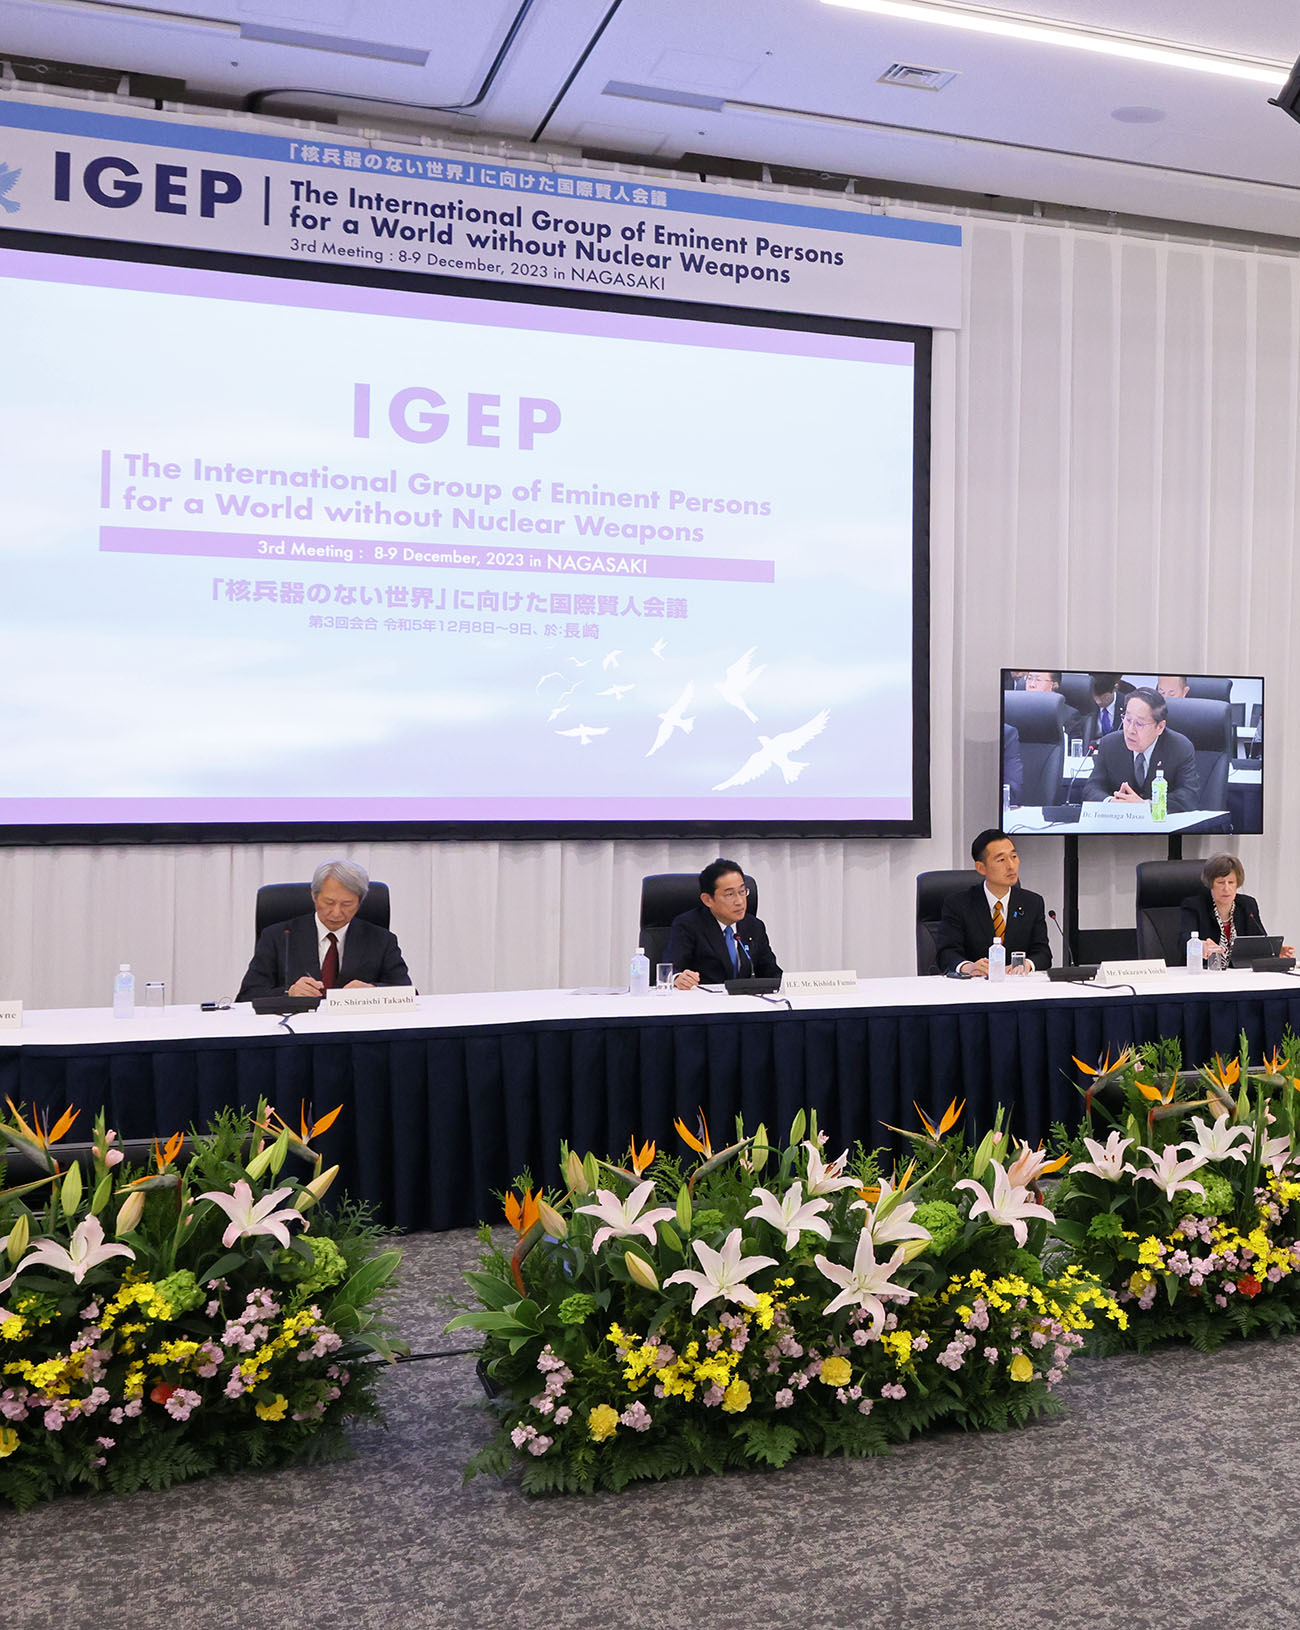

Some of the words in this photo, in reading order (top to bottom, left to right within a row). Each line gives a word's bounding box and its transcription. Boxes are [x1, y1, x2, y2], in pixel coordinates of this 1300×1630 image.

[53, 151, 243, 218] IGEP
[288, 143, 668, 207] 「核兵器のない世界」に向けた国際賢人会議
[290, 180, 338, 206] The
[350, 187, 522, 228] International
[532, 209, 611, 243] Group
[621, 221, 645, 242] of
[654, 225, 748, 255] Eminent
[756, 237, 844, 266] Persons
[290, 205, 331, 231] for
[343, 219, 359, 235] a
[371, 216, 453, 245] World
[466, 229, 566, 259] without
[576, 240, 671, 270] Nuclear
[680, 252, 790, 284] Weapons
[290, 238, 316, 253] 3rd
[322, 242, 383, 263] Meeting
[398, 250, 421, 264] 8-9
[427, 253, 504, 275] December,
[511, 262, 548, 278] 2023
[553, 266, 566, 280] in
[571, 267, 665, 290] NAGASAKI
[353, 383, 562, 450] IGEP
[124, 453, 182, 479] The
[194, 458, 397, 493] International
[407, 473, 502, 505] Group
[512, 479, 542, 502] of
[551, 482, 660, 509] Eminent
[669, 489, 772, 516] Persons
[123, 486, 172, 512] for
[184, 497, 204, 514] a
[216, 493, 313, 521] World
[324, 500, 443, 528] without
[453, 507, 566, 534] Nuclear
[574, 514, 704, 545] Weapons
[257, 540, 285, 555] 3rd
[291, 542, 353, 561] Meeting
[374, 546, 398, 560] 8-9
[403, 547, 481, 567] December,
[487, 552, 524, 567] 2023
[530, 554, 541, 567] in
[547, 554, 648, 575] NAGASAKI
[212, 577, 688, 620] 「核兵器のない世界」に向けた国際賢人会議
[309, 615, 379, 631] 第3回会合
[330, 999, 342, 1007] Dr.
[344, 998, 380, 1006] Shiraishi
[383, 996, 414, 1005] Takashi
